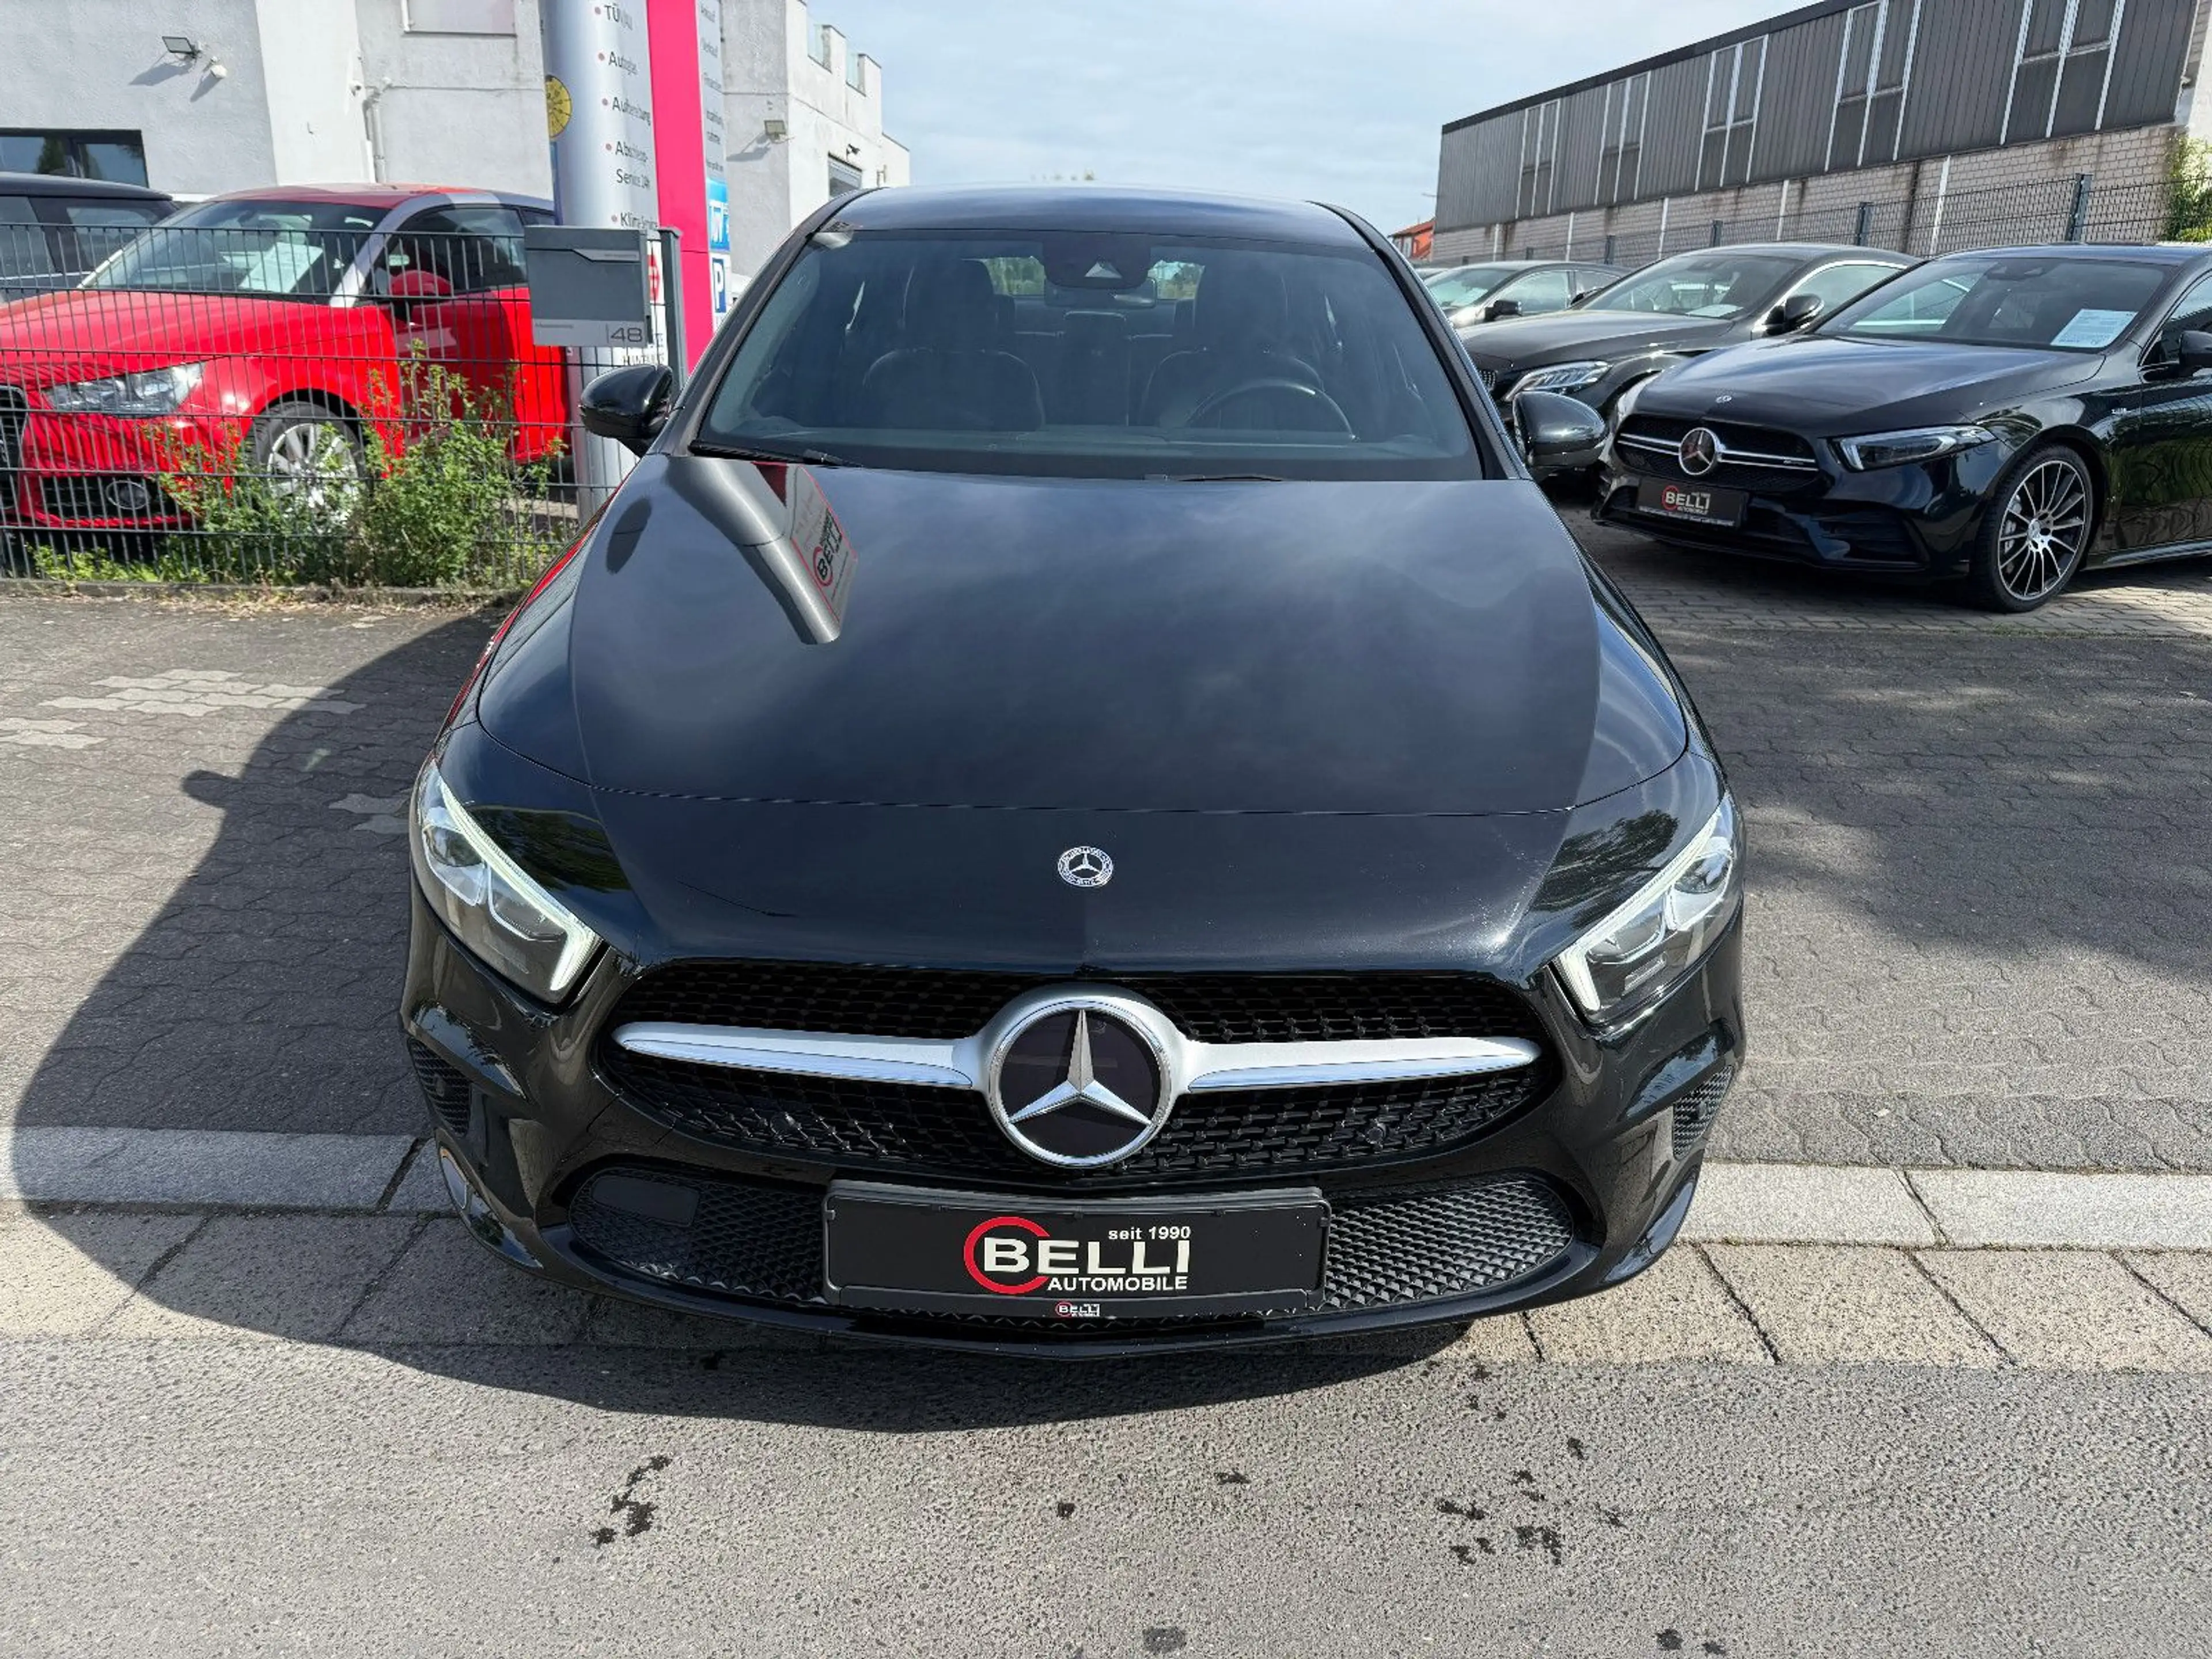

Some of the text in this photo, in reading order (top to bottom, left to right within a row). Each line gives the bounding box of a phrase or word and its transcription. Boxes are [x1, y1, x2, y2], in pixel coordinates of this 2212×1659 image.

[611, 327, 643, 343] 48
[1665, 491, 1711, 510] BELLI
[1108, 1226, 1191, 1240] seit 1990
[984, 1237, 1190, 1275] BELLI
[1047, 1275, 1188, 1291] AUTOMOBILE
